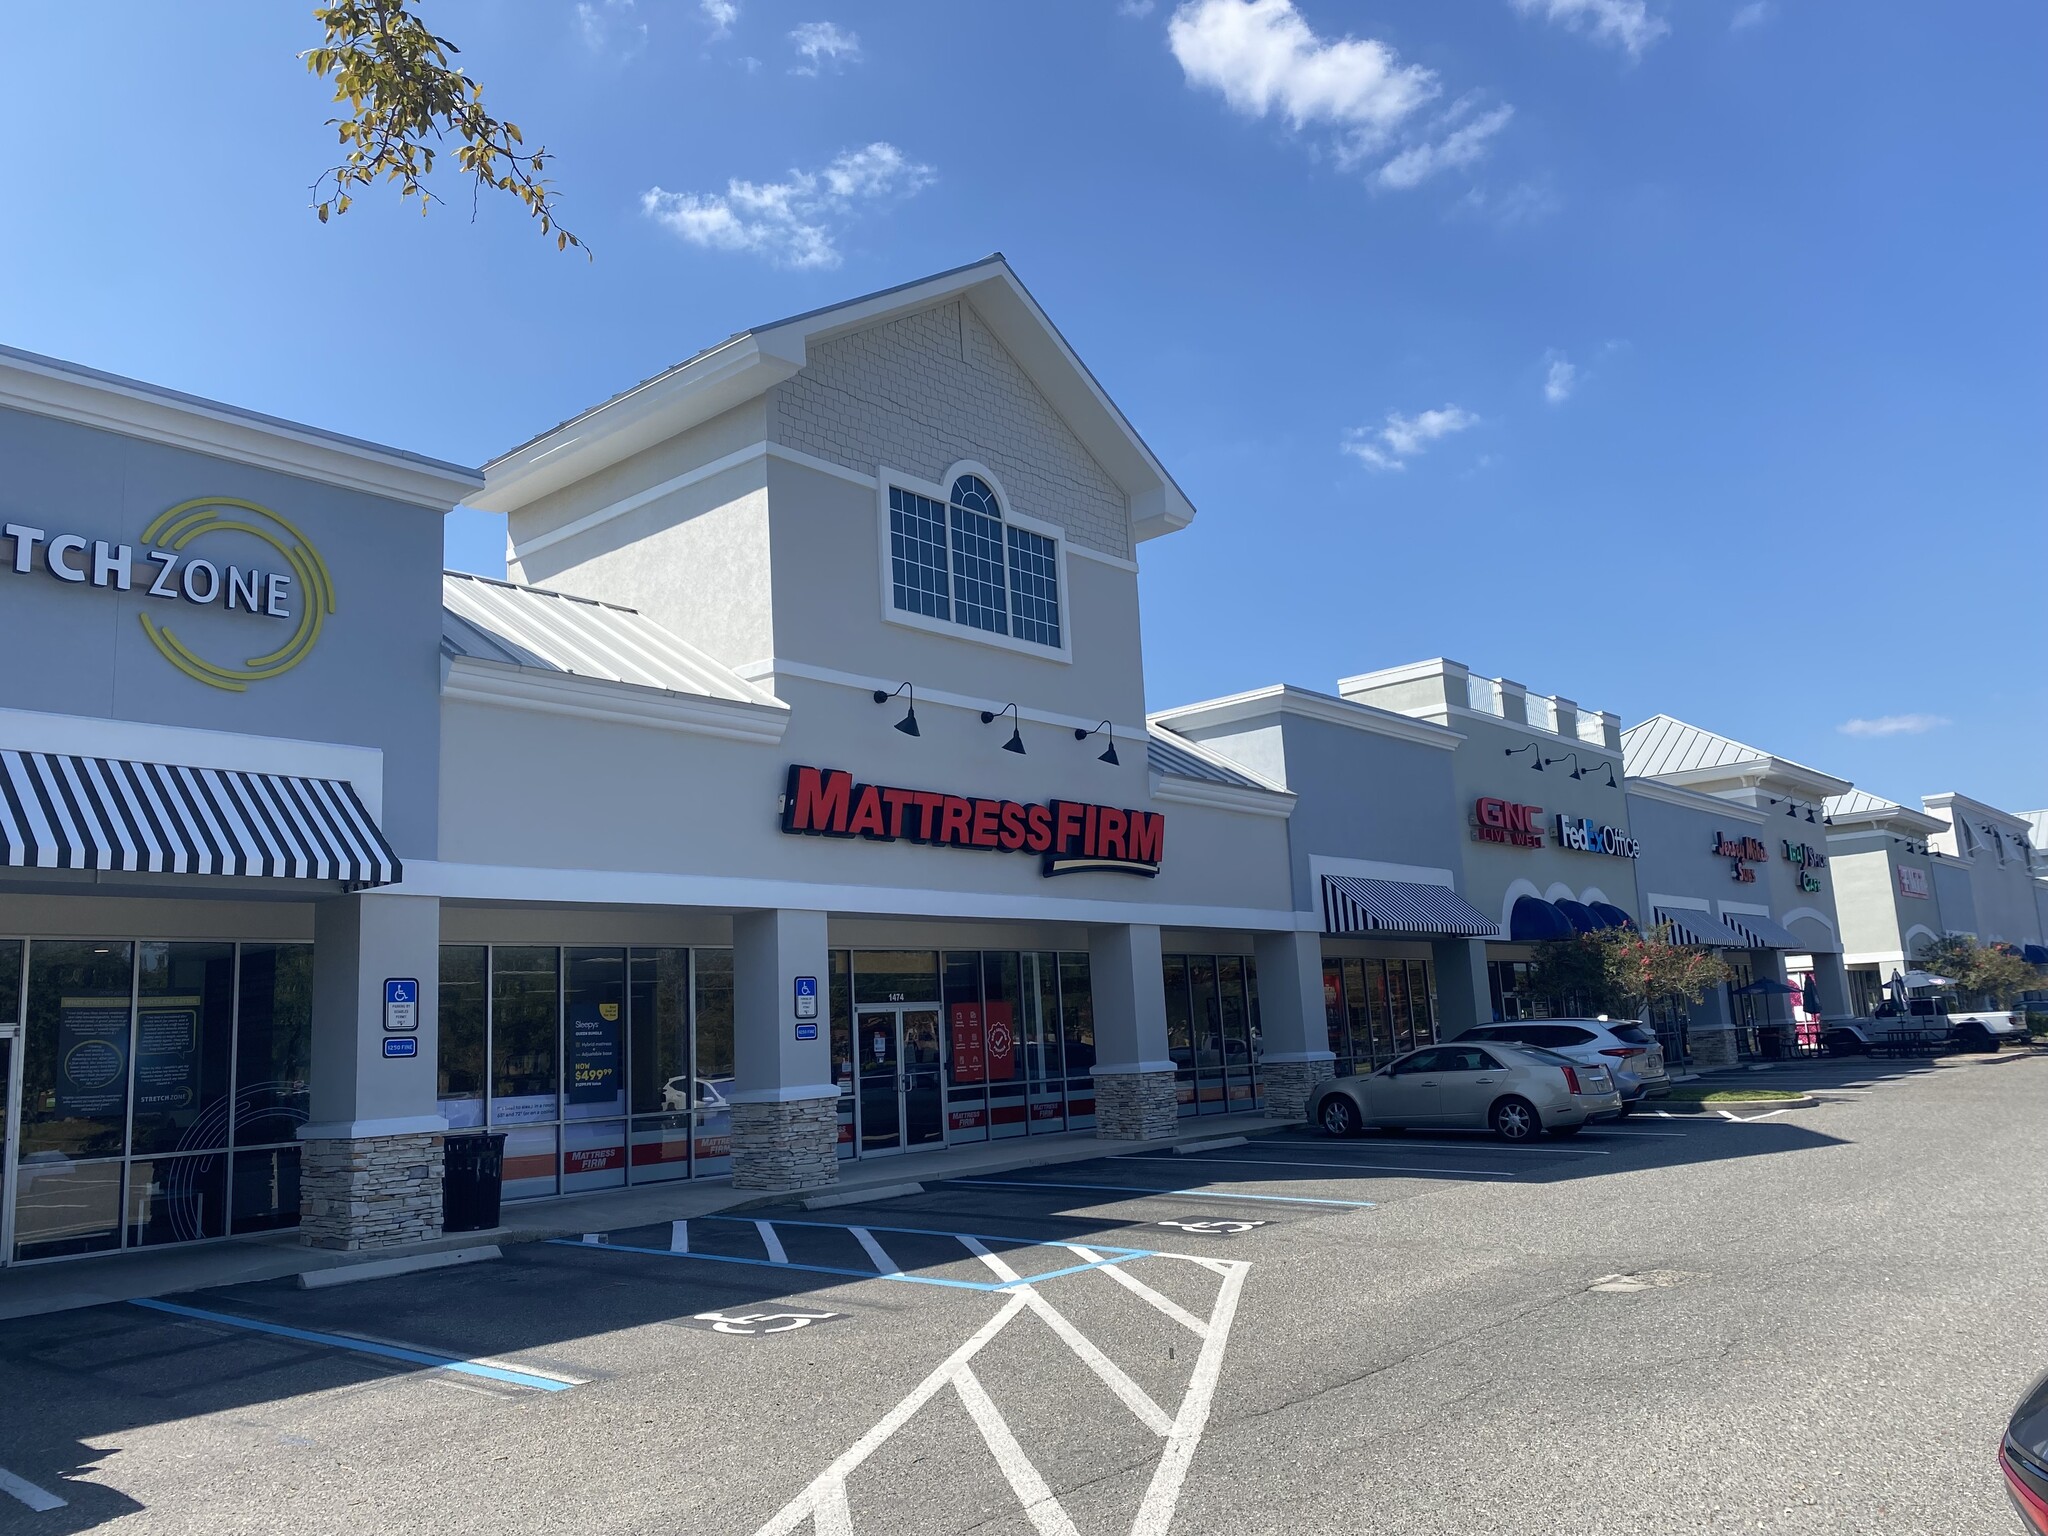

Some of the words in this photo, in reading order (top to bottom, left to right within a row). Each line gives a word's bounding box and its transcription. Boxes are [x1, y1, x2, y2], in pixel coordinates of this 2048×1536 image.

[3, 522, 133, 591] TCH
[147, 551, 292, 618] ZONE
[1476, 796, 1545, 835] GNC
[888, 993, 904, 1002] 1474
[575, 1062, 590, 1070] NOW
[572, 1148, 616, 1161] MATTRESS
[581, 1157, 607, 1169] FIRM
